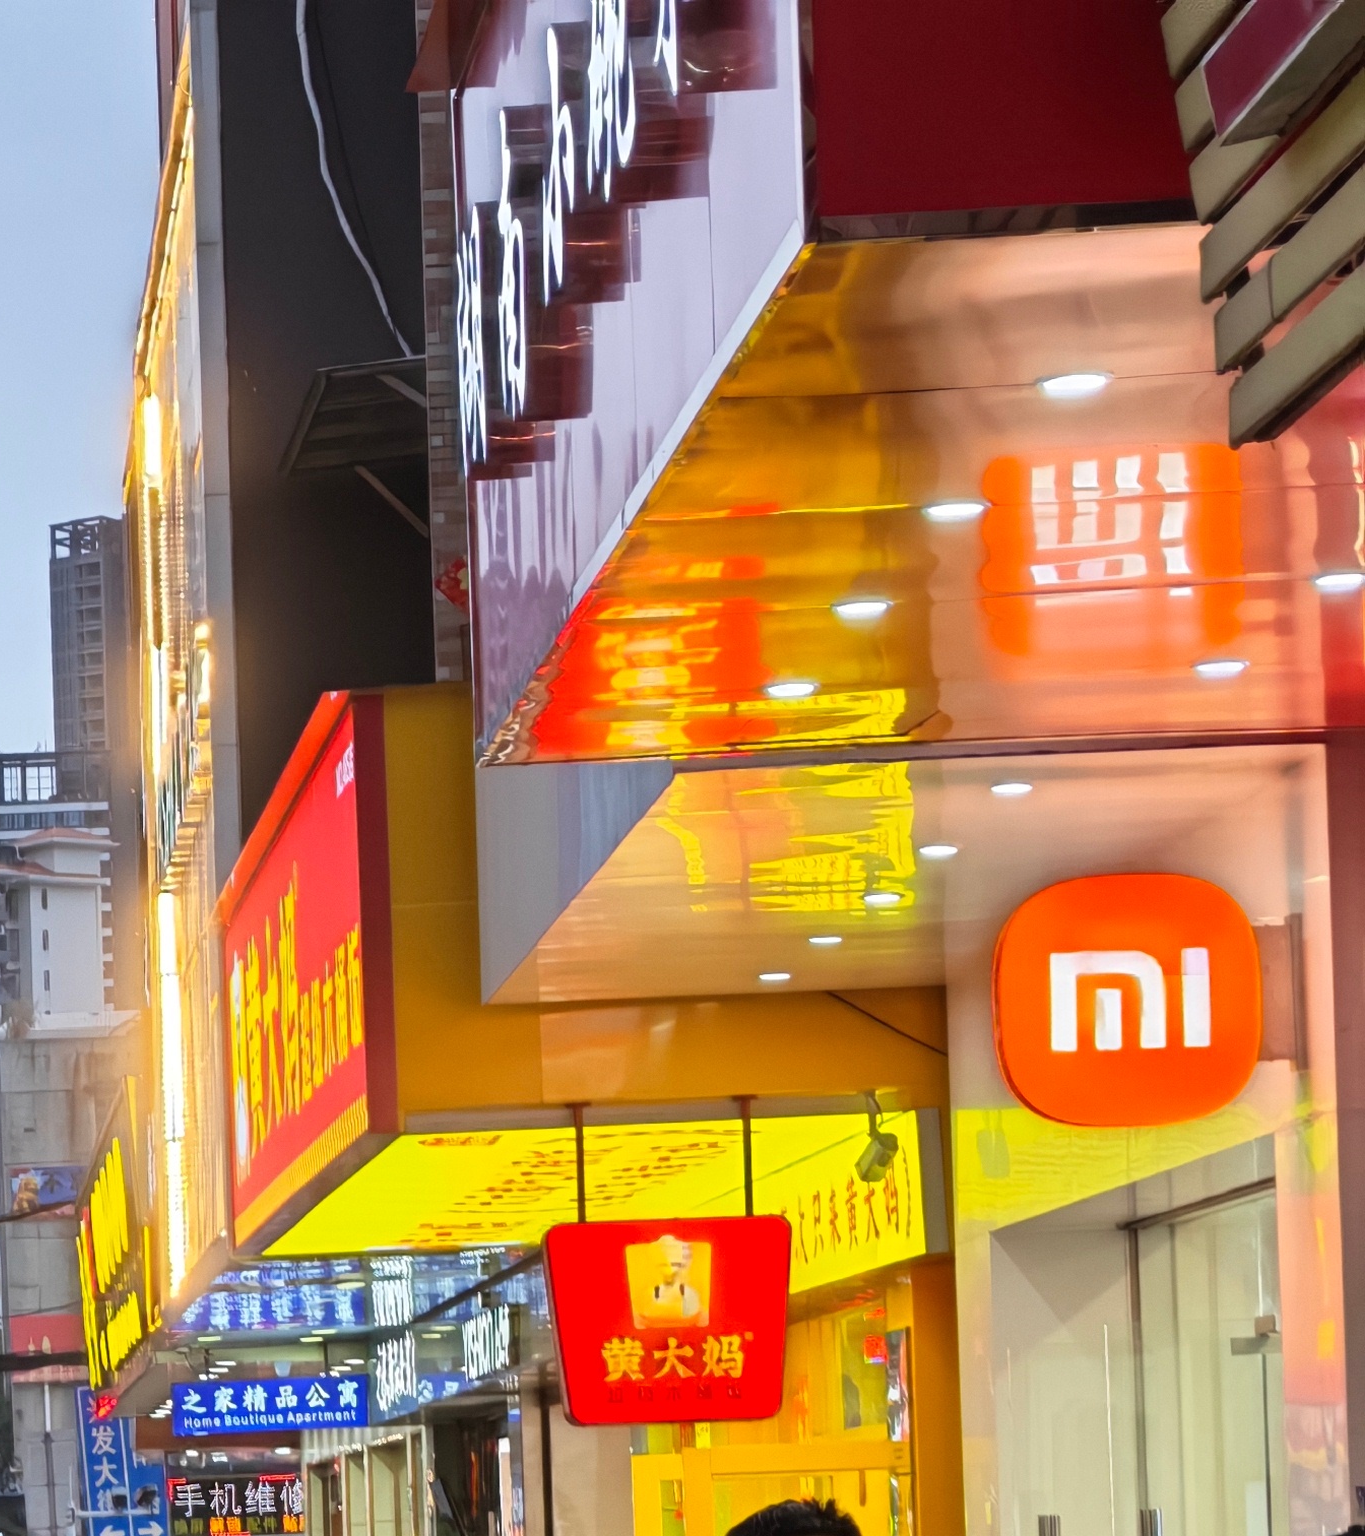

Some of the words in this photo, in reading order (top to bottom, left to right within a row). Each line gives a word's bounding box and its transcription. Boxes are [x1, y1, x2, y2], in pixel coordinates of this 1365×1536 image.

[601, 1334, 745, 1382] 黄大妈
[181, 1380, 359, 1414] 之家精品公寓
[184, 1415, 220, 1430] Home
[224, 1411, 283, 1428] Boutique
[286, 1409, 357, 1424] Apartment
